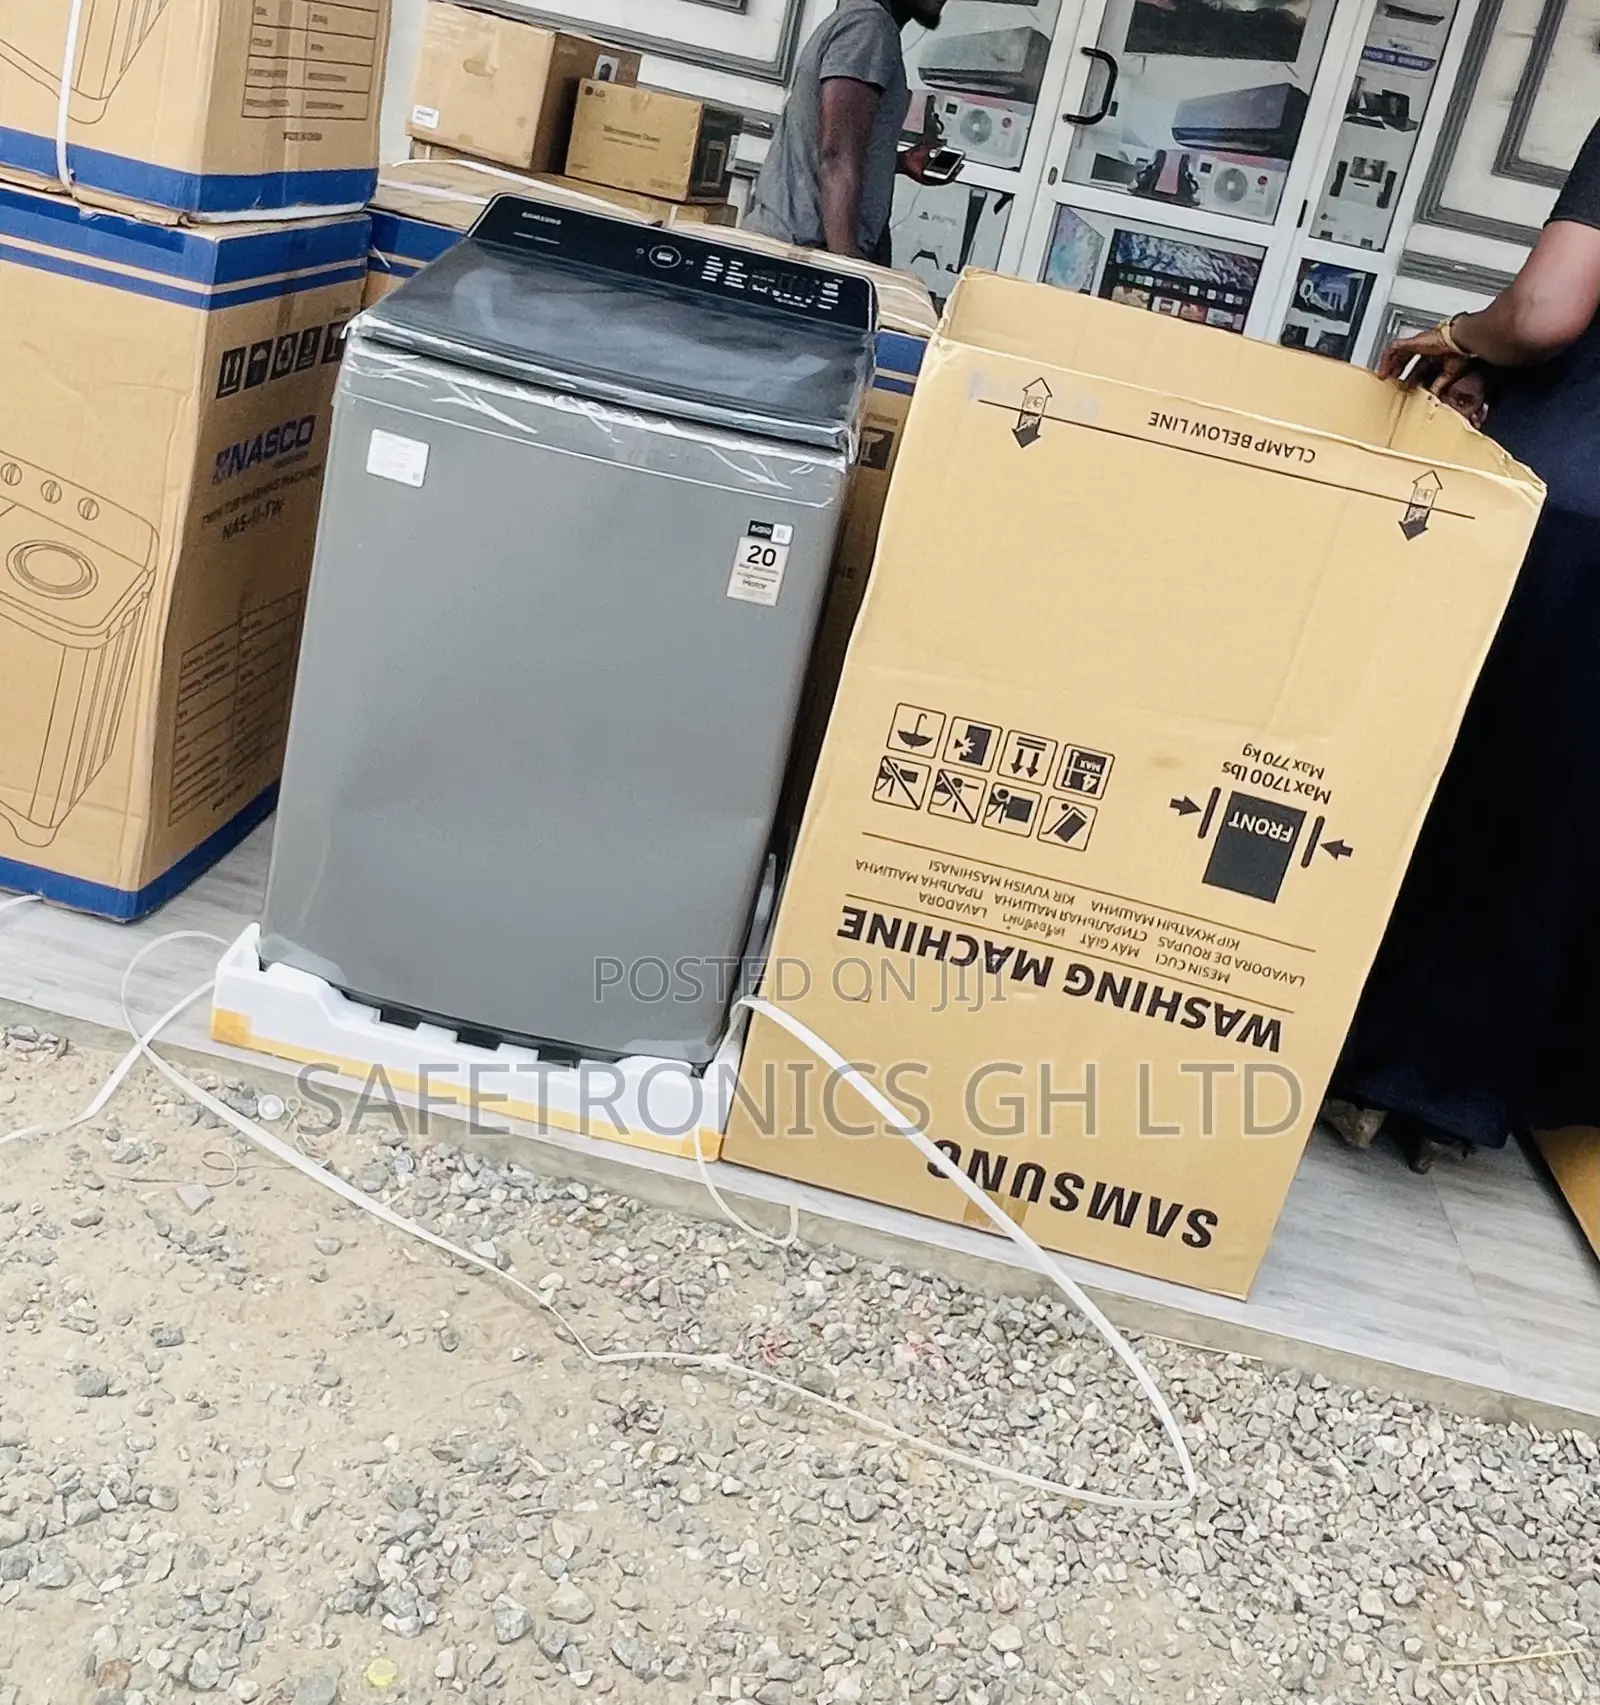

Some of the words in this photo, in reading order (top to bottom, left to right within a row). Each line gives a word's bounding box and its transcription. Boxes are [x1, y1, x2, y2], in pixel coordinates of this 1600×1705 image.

[1147, 411, 1189, 434] LINE
[1189, 422, 1253, 449] BELOW
[227, 413, 318, 478] NASCO
[1254, 437, 1317, 464] CLAMP
[747, 544, 777, 567] 20
[1241, 743, 1262, 763] kg
[1263, 751, 1291, 771] 770
[1221, 761, 1249, 782] lbs
[1250, 768, 1292, 793] 1700
[1292, 759, 1326, 780] Max
[1294, 779, 1333, 805] Max
[1227, 811, 1295, 843] FRONT
[855, 859, 919, 884] МАШИНА
[928, 859, 1001, 887] MASHINASI
[920, 874, 984, 900] ПРАЛЬНА
[1053, 890, 1076, 906] KIR
[918, 891, 988, 919] LAVADORA
[994, 893, 1057, 919] МАШИНА
[1091, 899, 1155, 927] МАШИНА
[1058, 910, 1148, 942] СТИРАЛЬНАЯ
[837, 905, 1055, 987] MACHINE
[1157, 935, 1213, 961] ROUPAS
[1214, 950, 1233, 966] DE
[1155, 953, 1187, 971] CUCI
[1188, 962, 1232, 984] MESIN
[1235, 957, 1306, 988] LAVADORA
[1062, 962, 1281, 1053] WASHING
